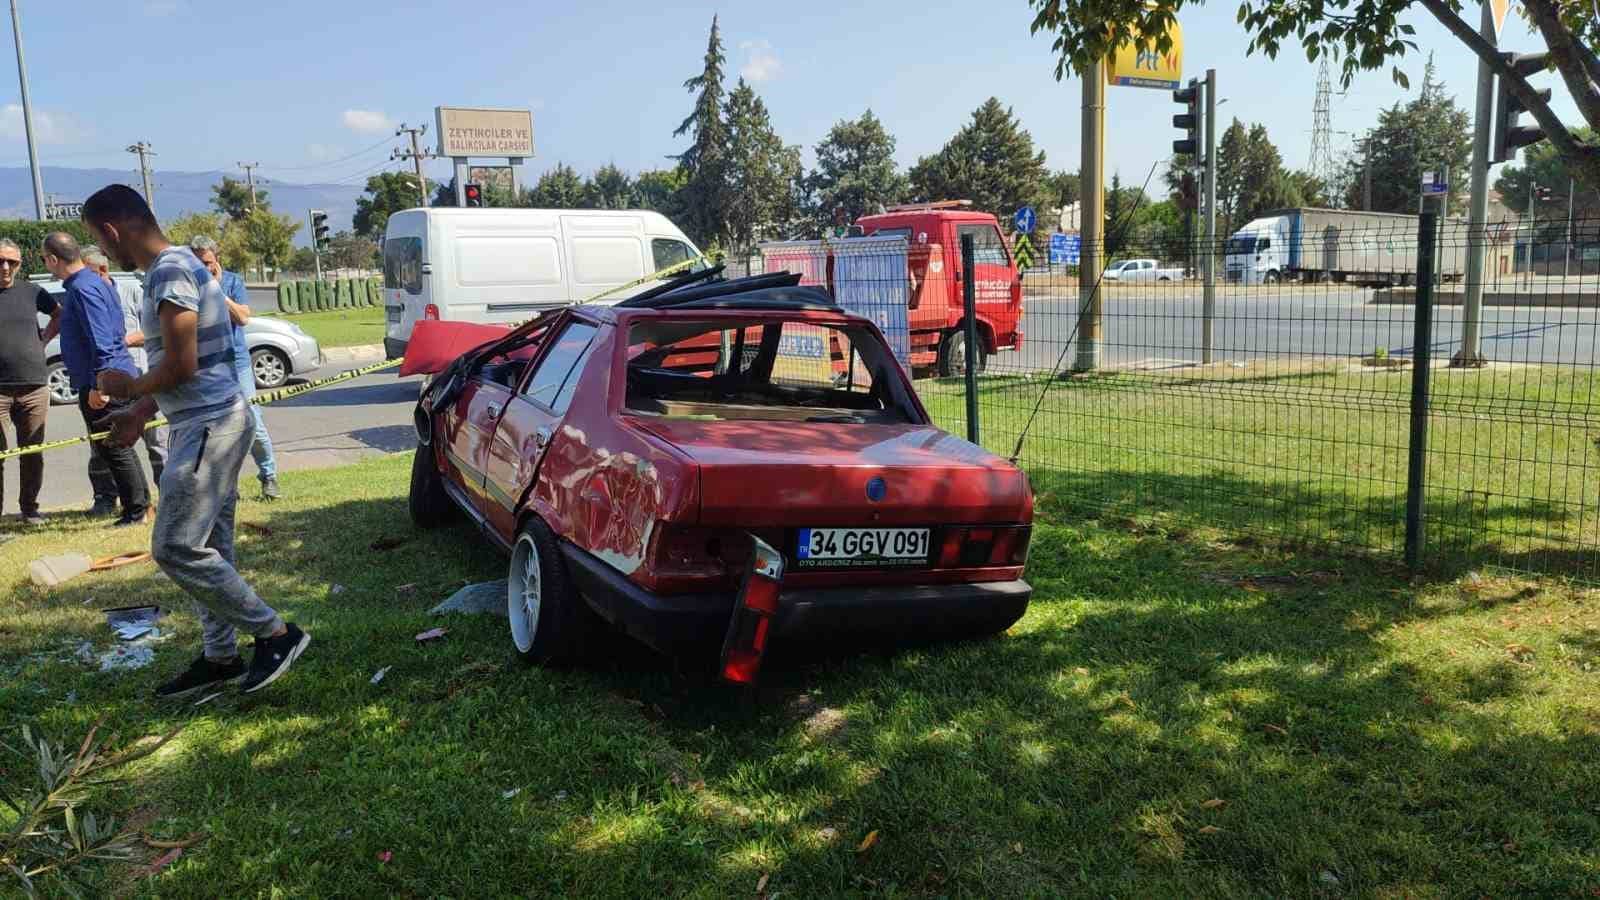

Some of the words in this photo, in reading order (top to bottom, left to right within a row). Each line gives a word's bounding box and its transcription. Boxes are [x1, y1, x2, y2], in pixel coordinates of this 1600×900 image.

[515, 128, 529, 139] VE
[811, 530, 837, 555] 34
[843, 530, 890, 555] GGV
[893, 531, 928, 555] 091
